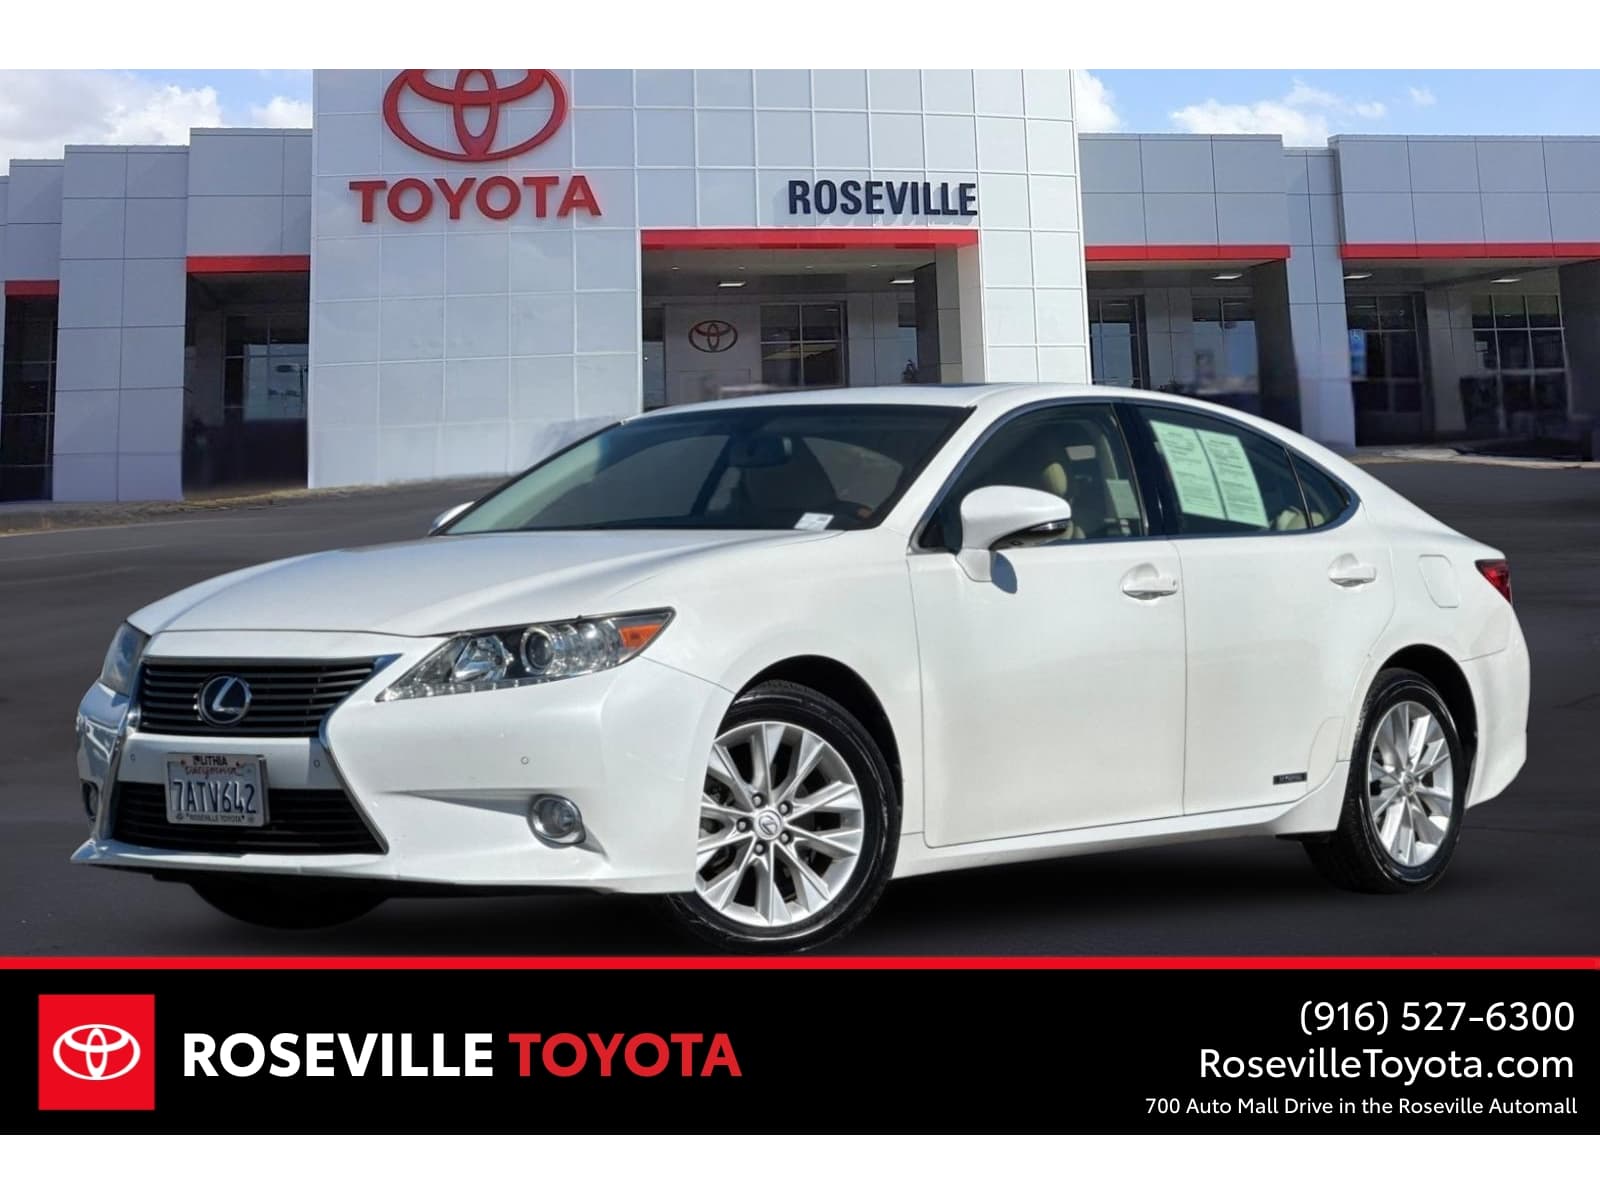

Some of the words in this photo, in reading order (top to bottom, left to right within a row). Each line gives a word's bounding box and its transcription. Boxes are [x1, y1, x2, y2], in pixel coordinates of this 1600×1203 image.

[349, 175, 602, 223] TOYOTA
[788, 180, 978, 216] ROSEVILLE
[172, 780, 257, 814] 7ATV642
